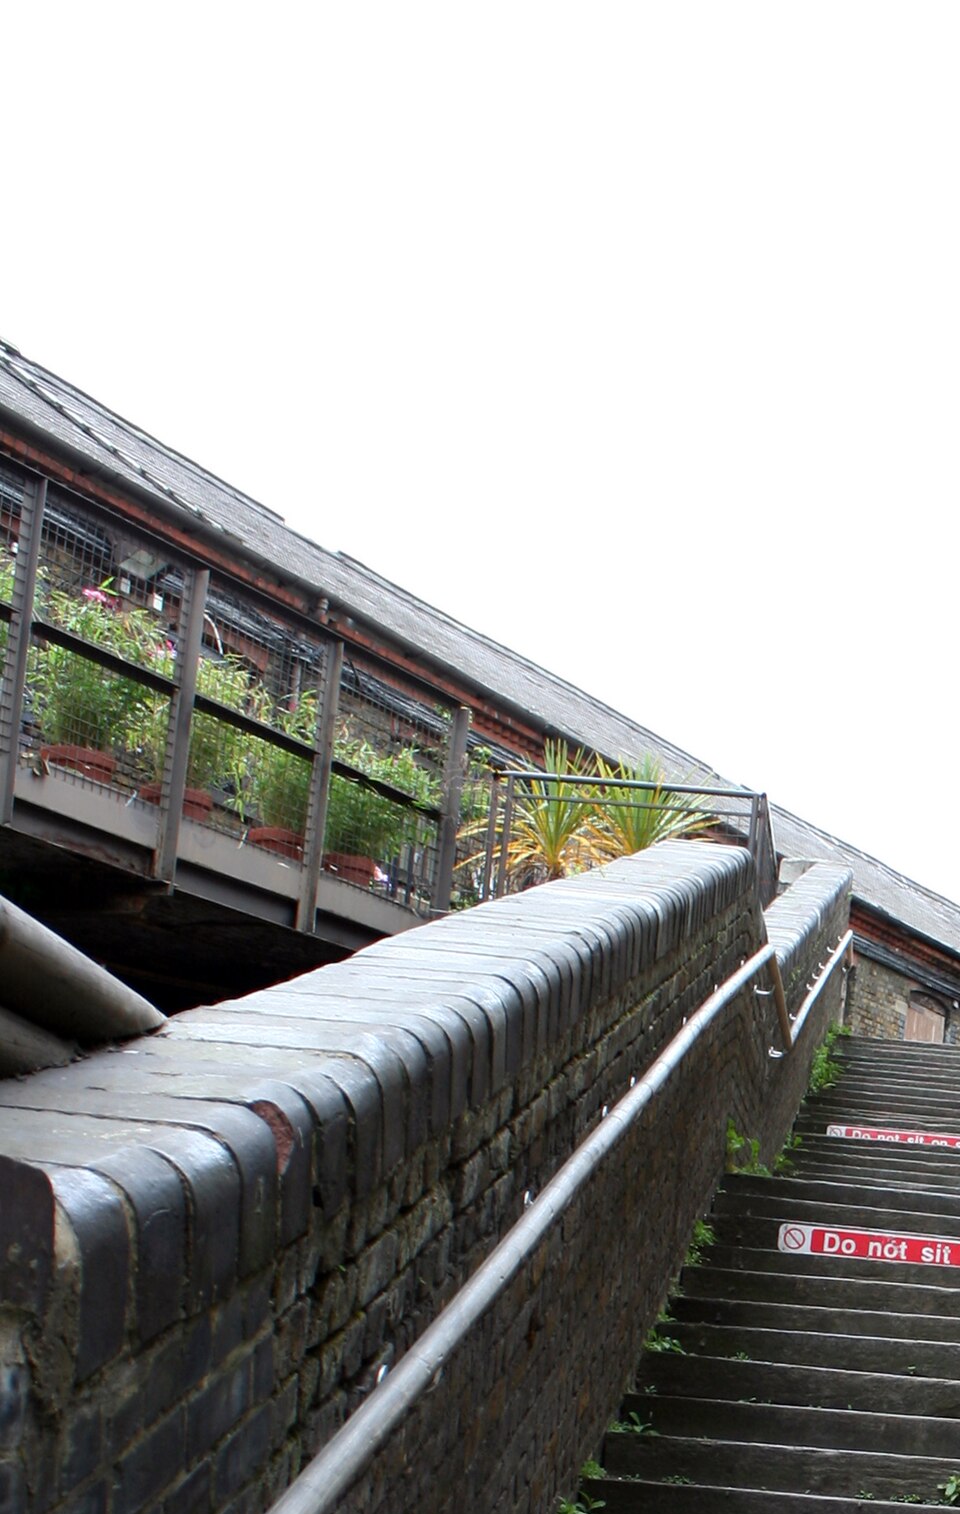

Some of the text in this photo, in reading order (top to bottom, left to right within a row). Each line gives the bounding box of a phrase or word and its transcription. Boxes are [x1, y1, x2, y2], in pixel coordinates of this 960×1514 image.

[823, 1232, 856, 1254] Do
[868, 1241, 907, 1259] not
[921, 1243, 951, 1264] sit
